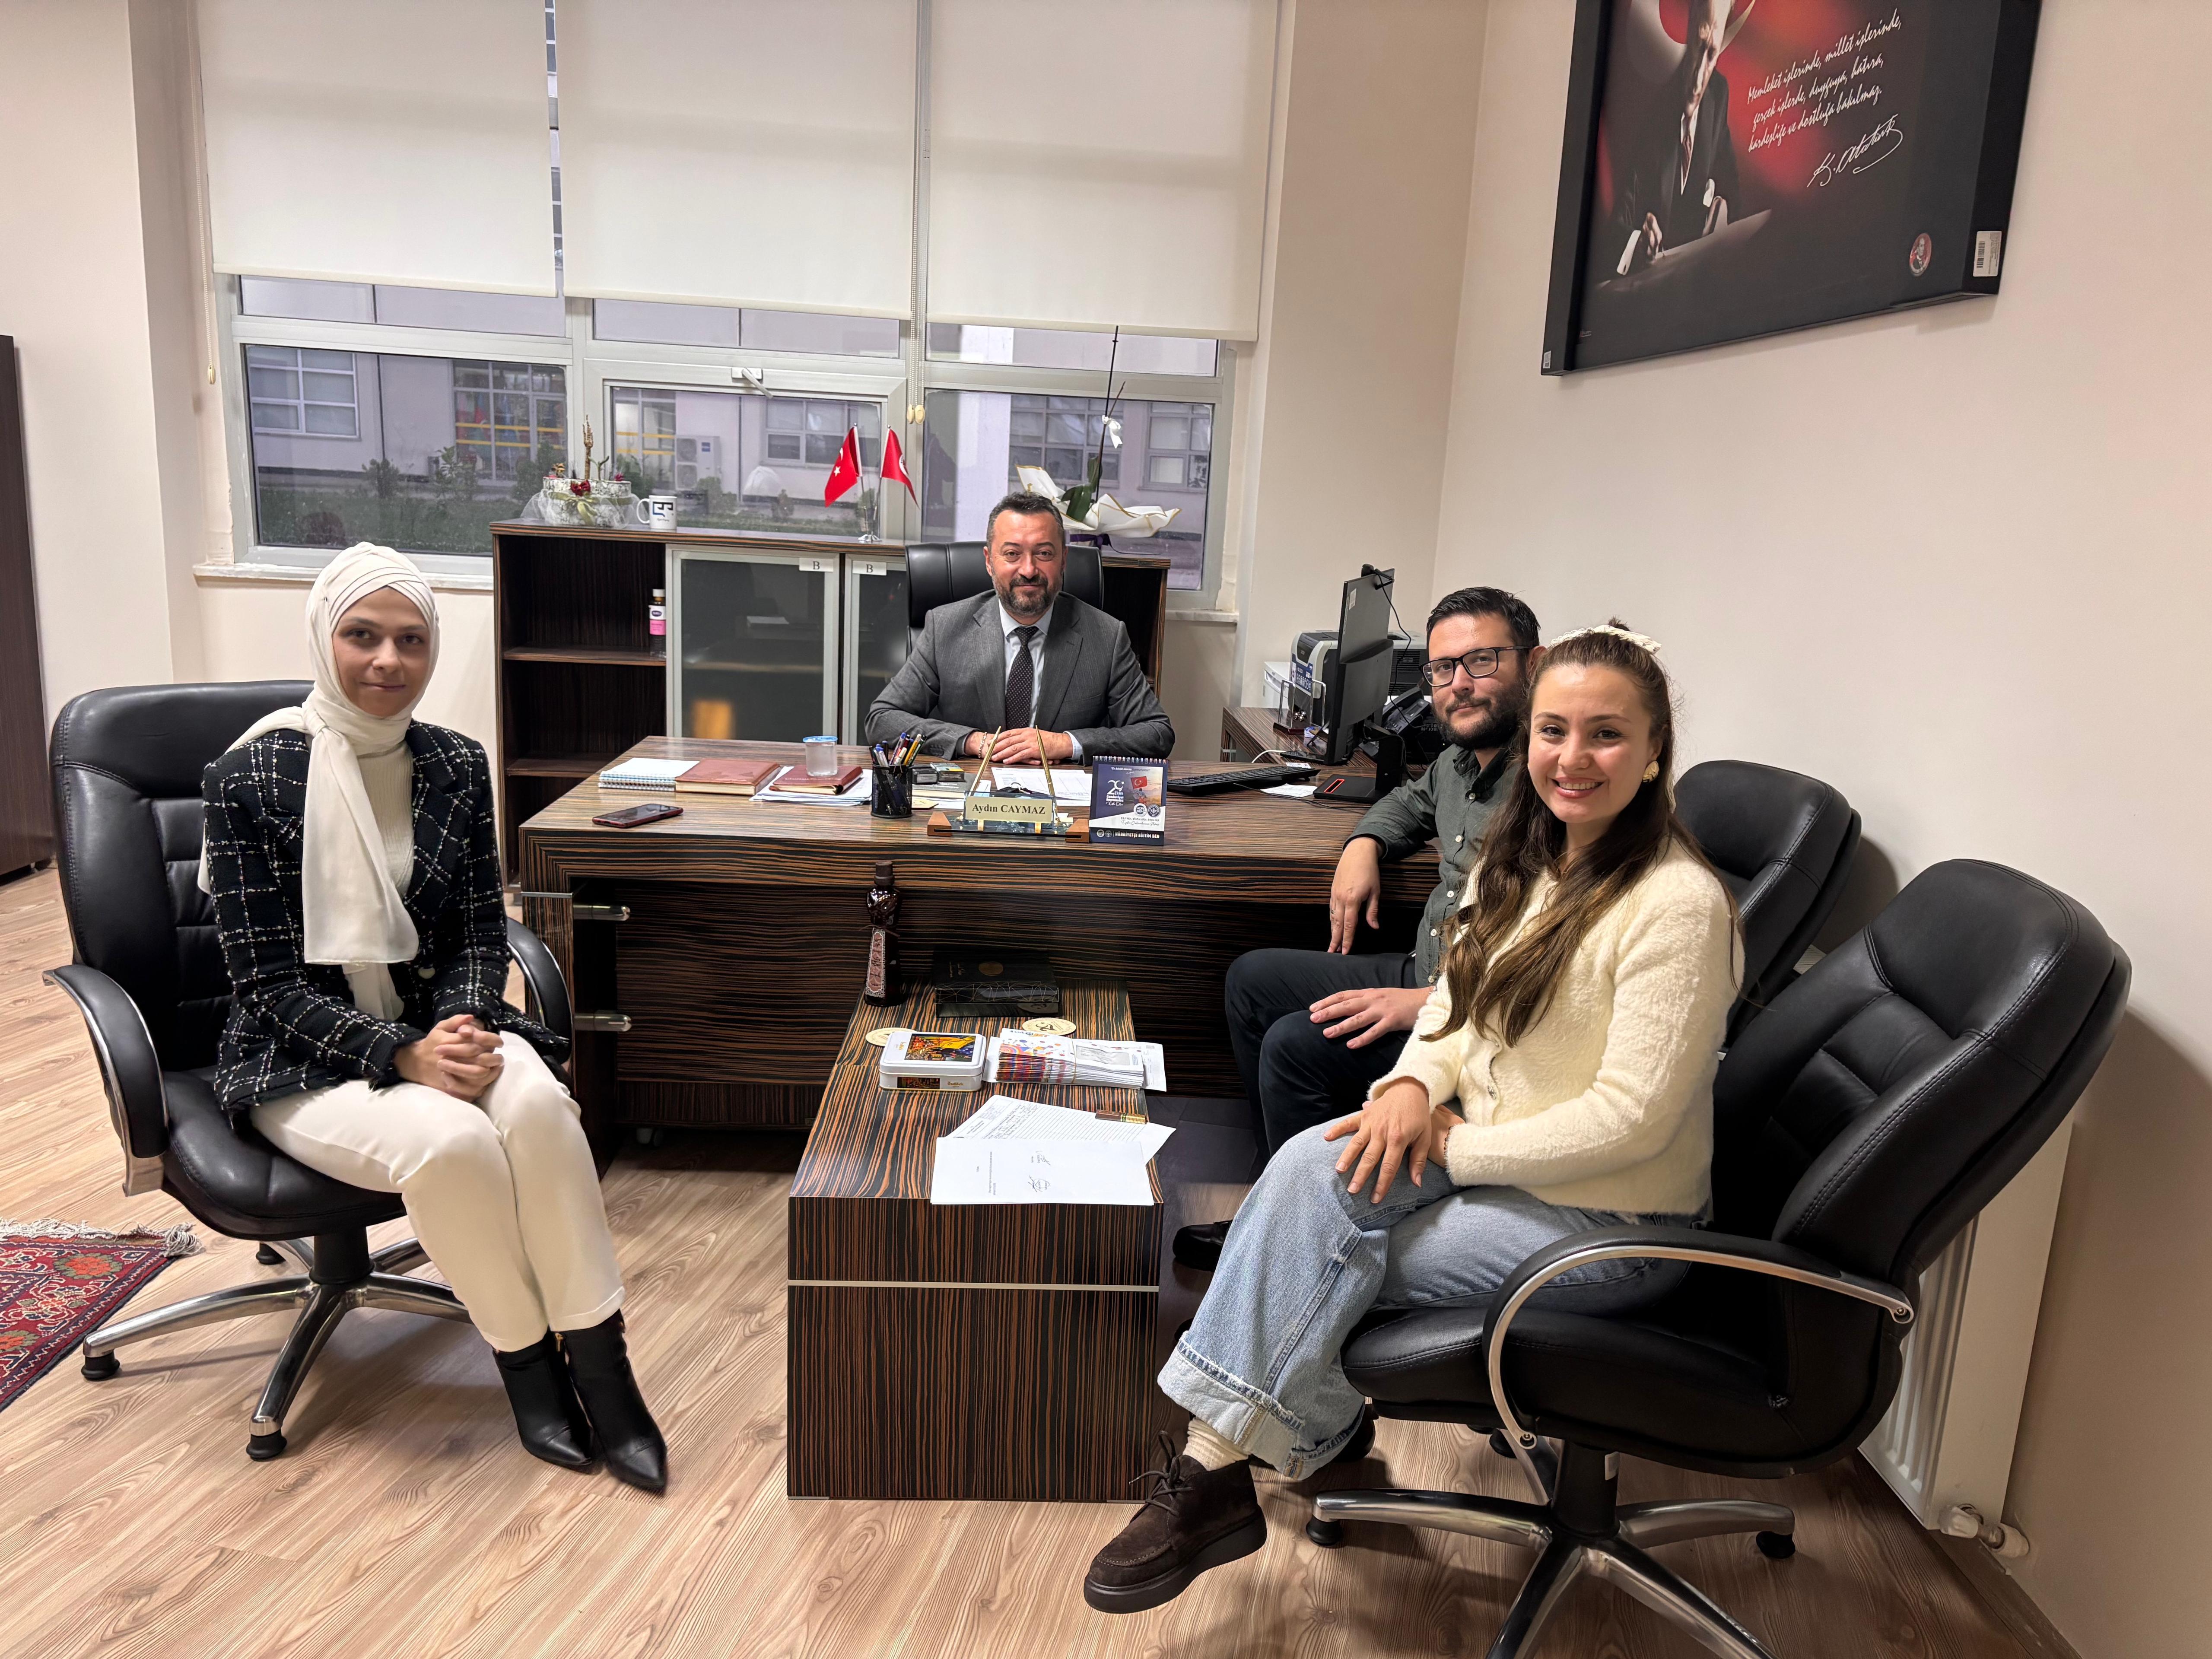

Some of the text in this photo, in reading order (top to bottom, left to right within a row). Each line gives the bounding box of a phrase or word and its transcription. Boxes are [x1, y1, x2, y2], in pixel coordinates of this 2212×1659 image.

[1824, 33, 1855, 63] millet
[1787, 121, 1797, 135] ve
[813, 561, 820, 570] B
[866, 564, 873, 573] B
[972, 804, 1046, 814] Aydın CAYMAZ
